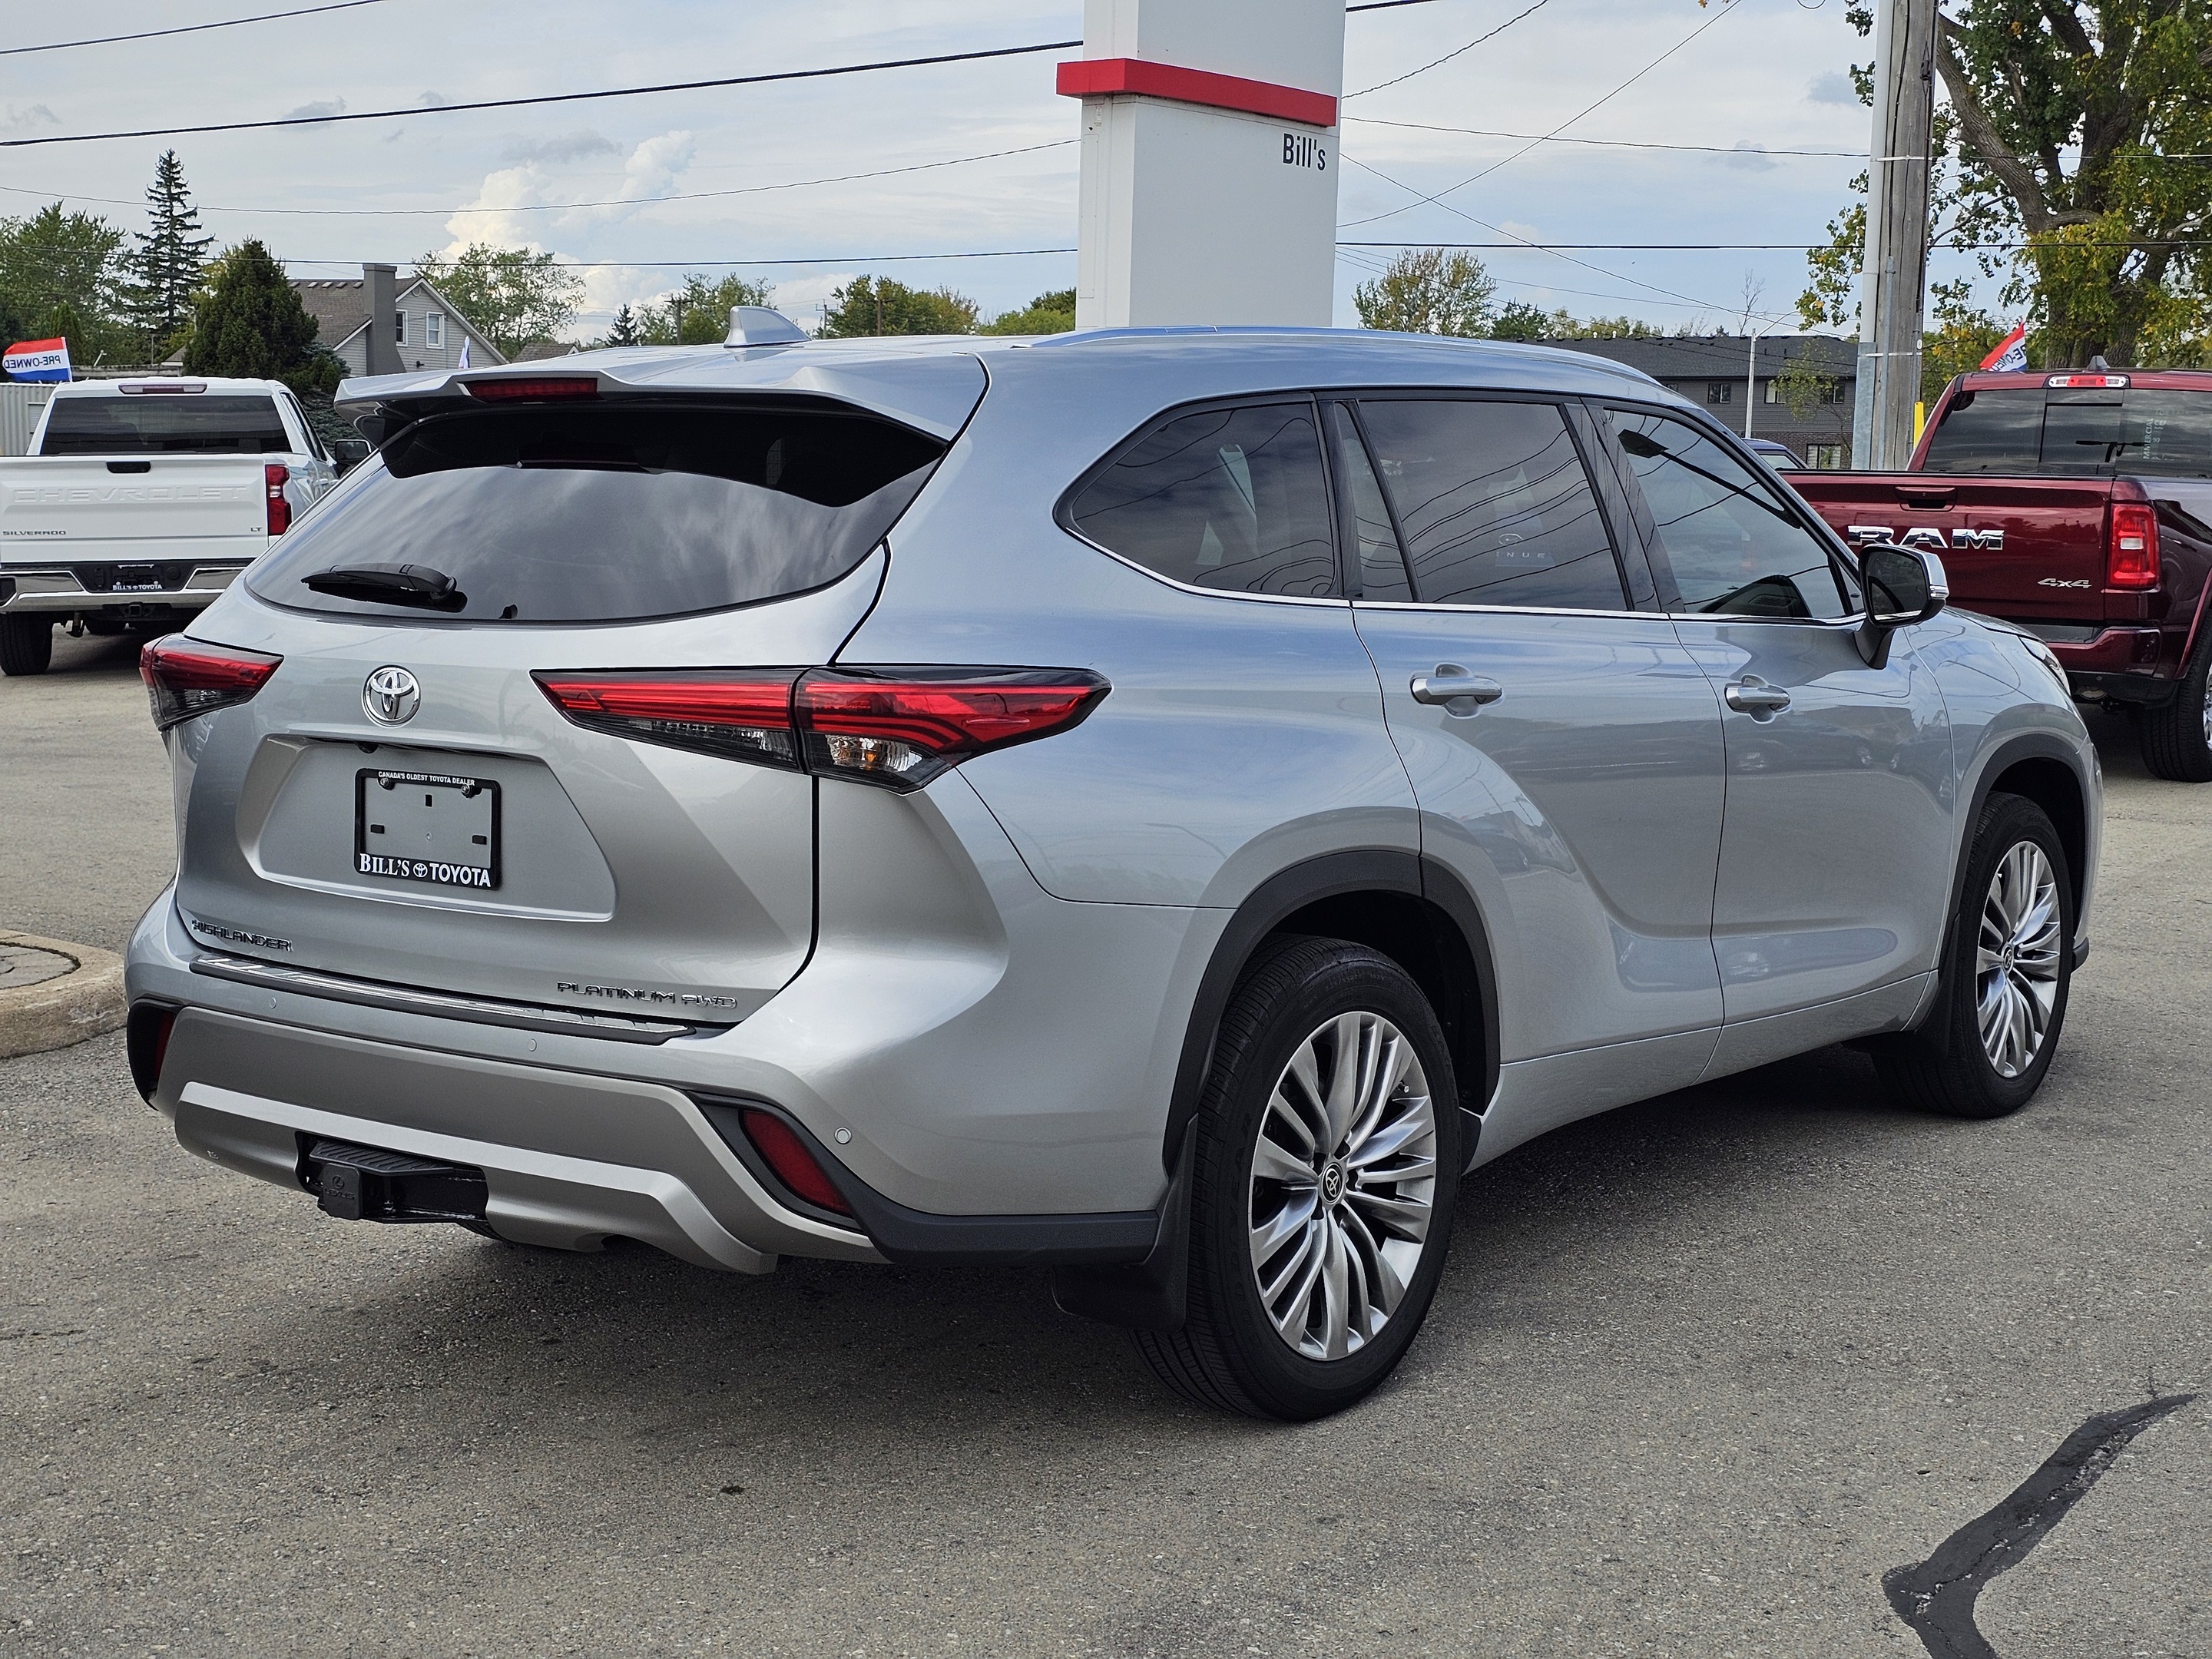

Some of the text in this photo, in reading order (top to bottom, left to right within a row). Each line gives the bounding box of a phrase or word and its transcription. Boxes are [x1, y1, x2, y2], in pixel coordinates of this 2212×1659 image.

[1283, 133, 1326, 171] Bill's
[13, 485, 247, 503] CHEVROLET
[1847, 525, 2005, 551] RAM
[2037, 578, 2092, 588] 4x4
[378, 771, 475, 786] CANADA'S OLDEST TOYOTA DEALER
[359, 853, 492, 888] BILL'S TOYOTA
[192, 919, 295, 952] HIGHLANDER
[557, 980, 738, 1010] PLATINUM AWD
[323, 1187, 356, 1200] LEXUS
